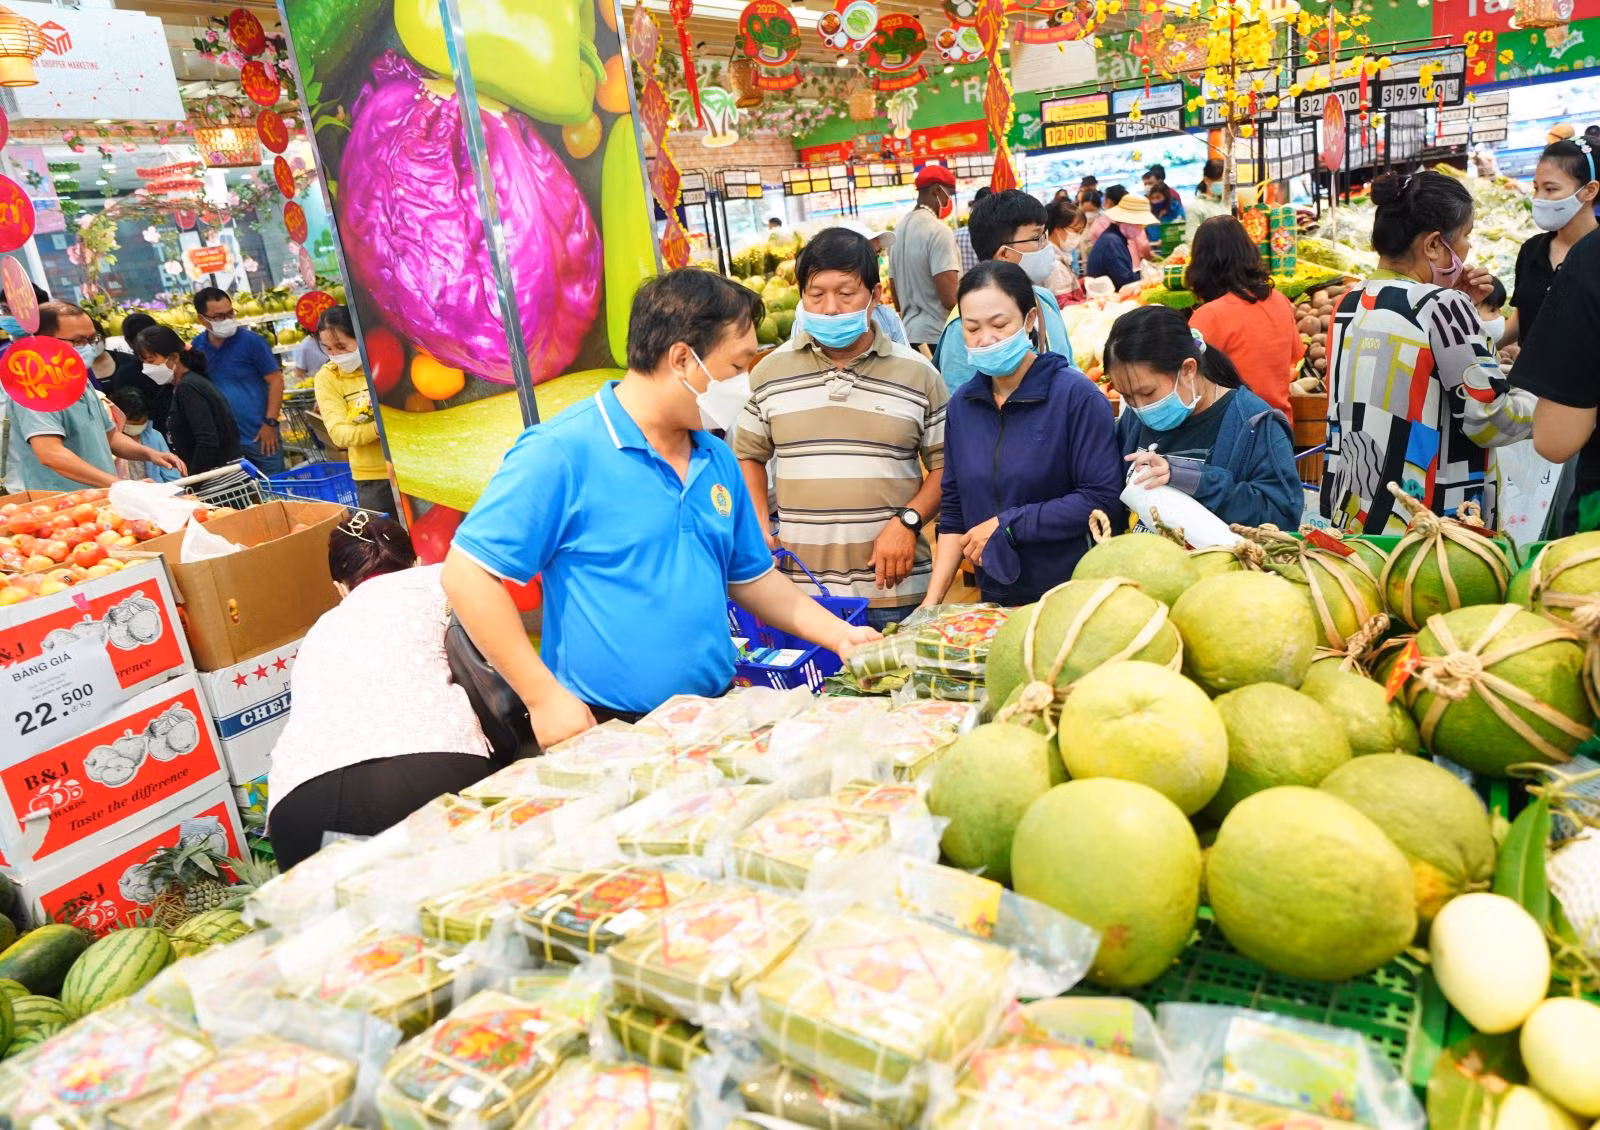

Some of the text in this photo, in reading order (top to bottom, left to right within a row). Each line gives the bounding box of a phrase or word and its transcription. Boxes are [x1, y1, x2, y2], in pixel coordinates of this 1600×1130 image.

[756, 4, 778, 14] 2023
[882, 17, 903, 28] 2023
[67, 61, 99, 71] MARKETING
[240, 695, 291, 726] CHEL
[24, 761, 69, 790] B&J
[69, 768, 189, 831] Taste the difference
